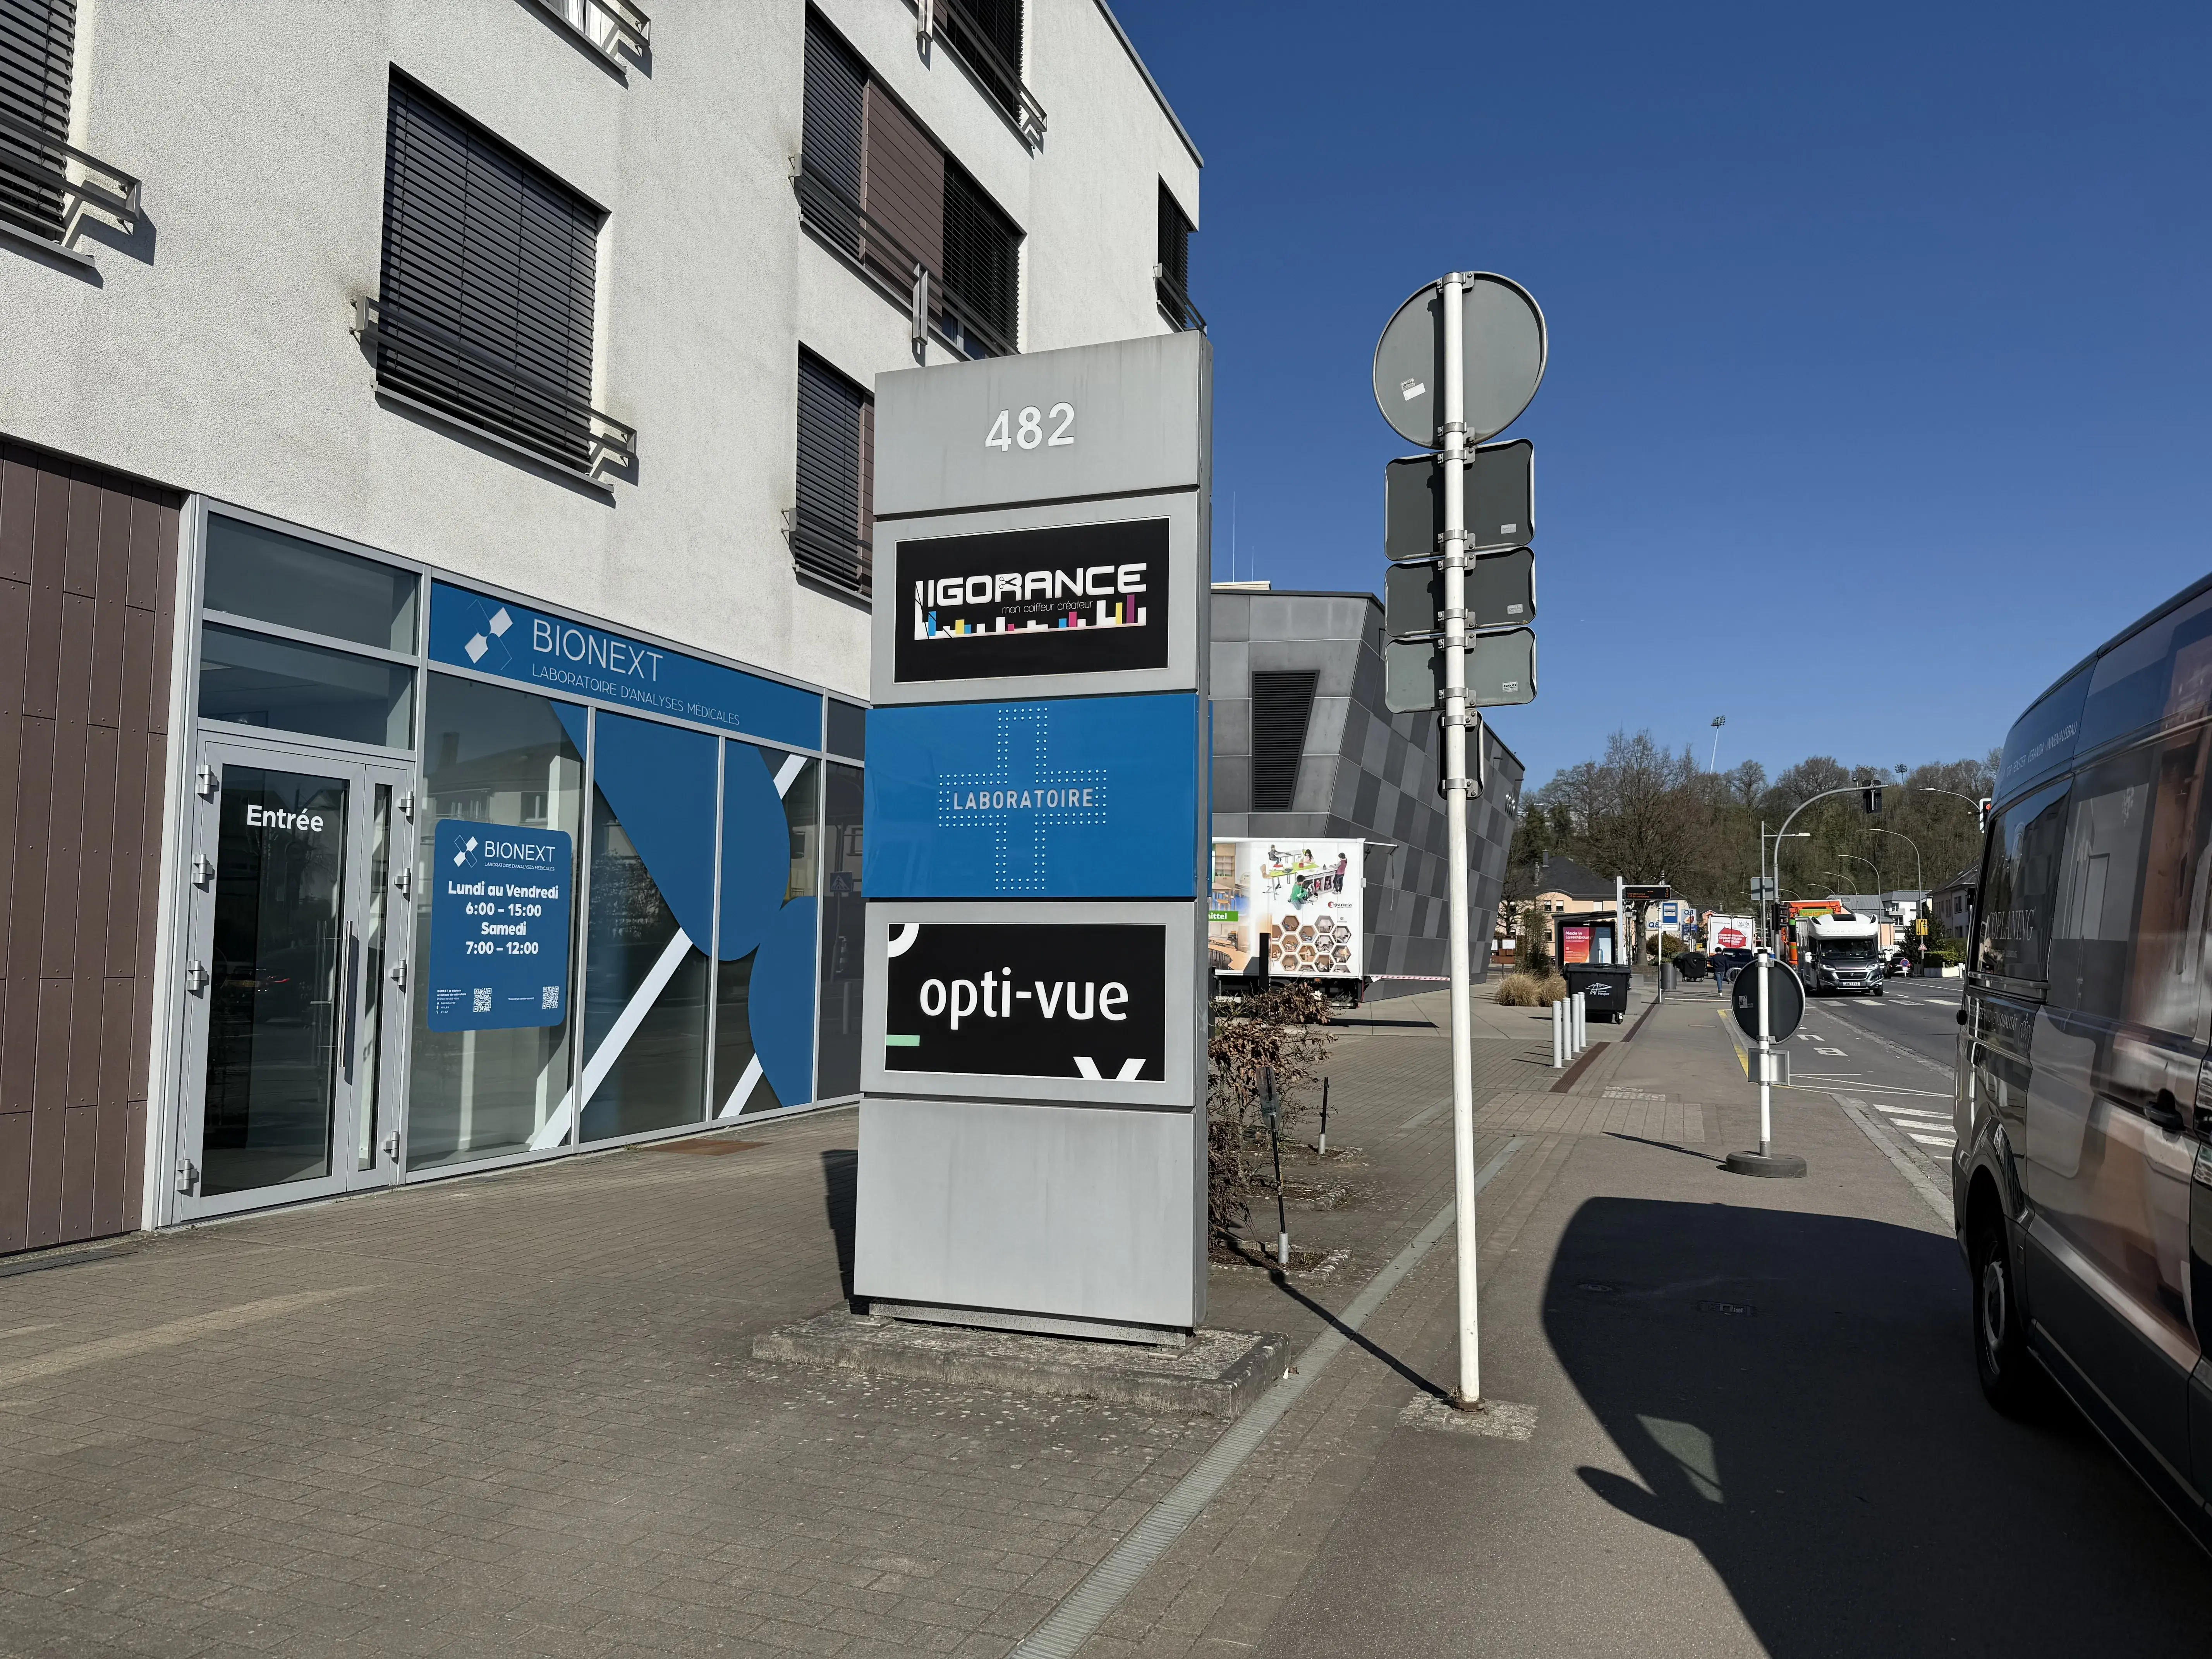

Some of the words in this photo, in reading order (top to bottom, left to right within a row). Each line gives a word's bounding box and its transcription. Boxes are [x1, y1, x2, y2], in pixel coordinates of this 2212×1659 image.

[985, 402, 1075, 452] 482
[1002, 606, 1020, 614] mon
[1024, 602, 1054, 612] coiffeur
[1058, 599, 1093, 611] créateur
[533, 618, 663, 682] BIONEXT
[532, 663, 617, 696] LABORATOIRE
[621, 685, 684, 712] D'ANALYSES
[687, 702, 740, 726] MÉDICALES
[953, 787, 1094, 810] LABORATOIRE
[247, 804, 324, 832] Entrée
[485, 840, 556, 862] BIONEXT
[448, 881, 485, 895] Lundi
[488, 885, 503, 896] au
[506, 884, 559, 899] Vendredi
[466, 902, 495, 915] 6:00
[508, 903, 542, 917] 15:00
[481, 921, 527, 935] Samedi
[466, 941, 494, 954] 7:00
[506, 941, 539, 954] 12:00
[920, 967, 1129, 1030] opti-vue
